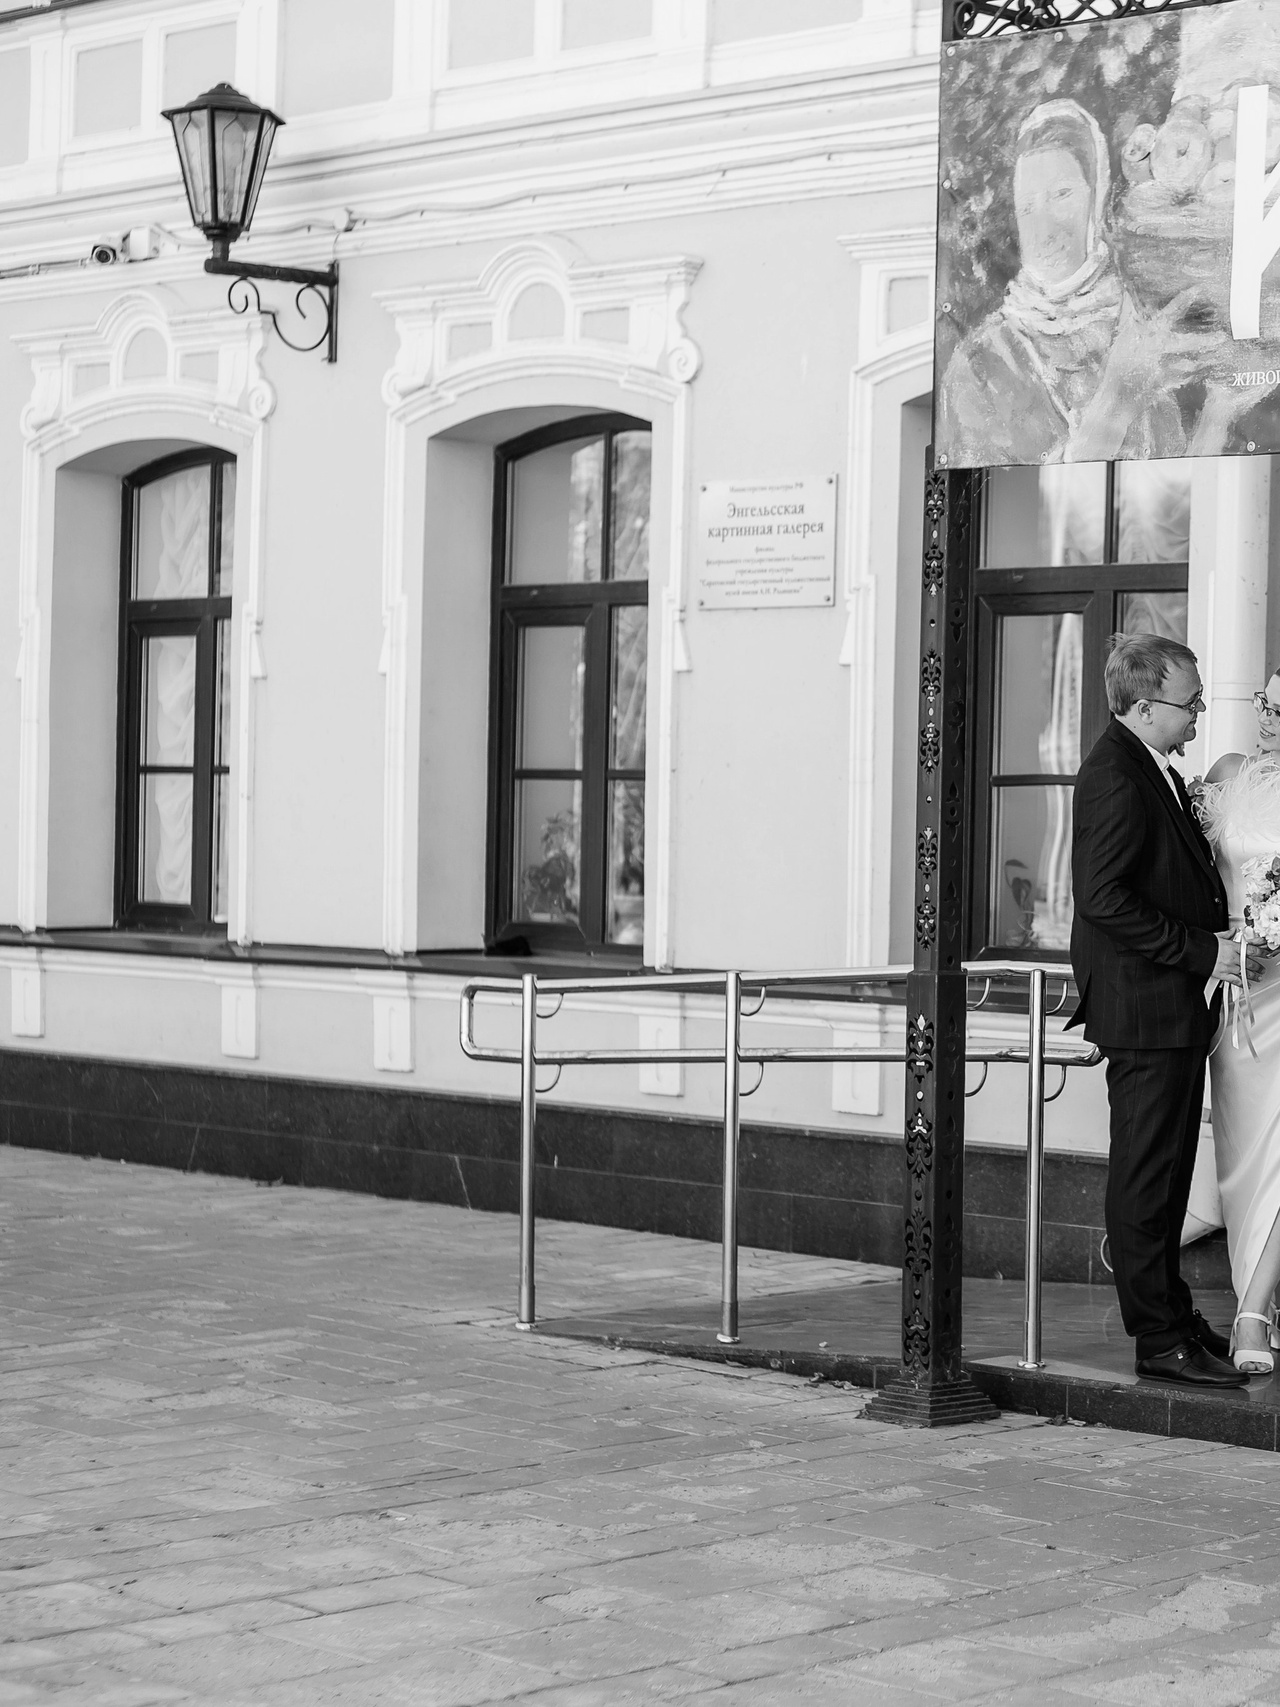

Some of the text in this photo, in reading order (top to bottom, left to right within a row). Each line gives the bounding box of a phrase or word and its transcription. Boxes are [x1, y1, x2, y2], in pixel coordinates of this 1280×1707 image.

[727, 503, 805, 518] Энгельсская
[708, 521, 825, 542] картинная галерея
